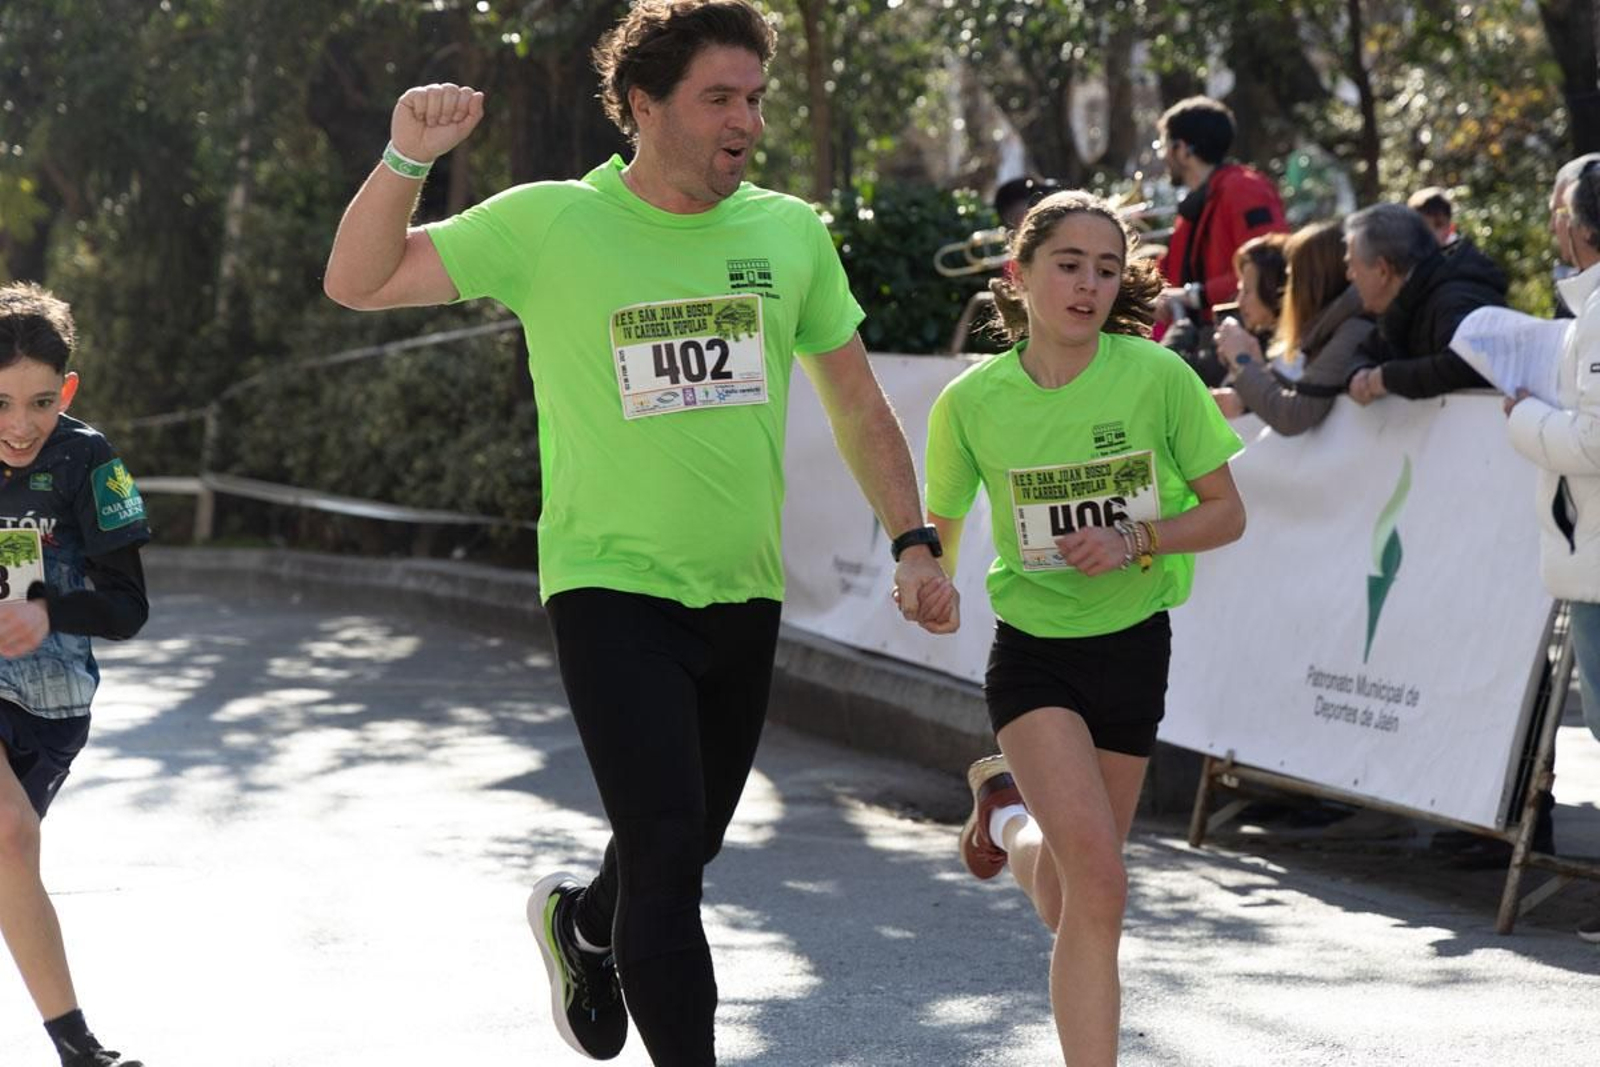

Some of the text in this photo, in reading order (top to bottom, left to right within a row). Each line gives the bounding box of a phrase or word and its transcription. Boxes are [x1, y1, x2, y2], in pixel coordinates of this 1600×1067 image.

[639, 308, 658, 323] SAN
[660, 305, 684, 321] JUAN
[686, 303, 713, 318] BOSCO
[622, 318, 708, 340] IV CARRERA POPULAR
[652, 338, 733, 385] 402
[1037, 471, 1055, 485] SAN
[1058, 467, 1082, 483] JUAN
[1085, 463, 1112, 479] BOSCO
[1022, 478, 1107, 500] IV CARRERA POPULAR
[102, 502, 124, 516] CAJA
[1049, 496, 1128, 537] 406
[1305, 664, 1420, 708] Patronato Municipal de
[1314, 694, 1399, 733] Deportes de Jaén
